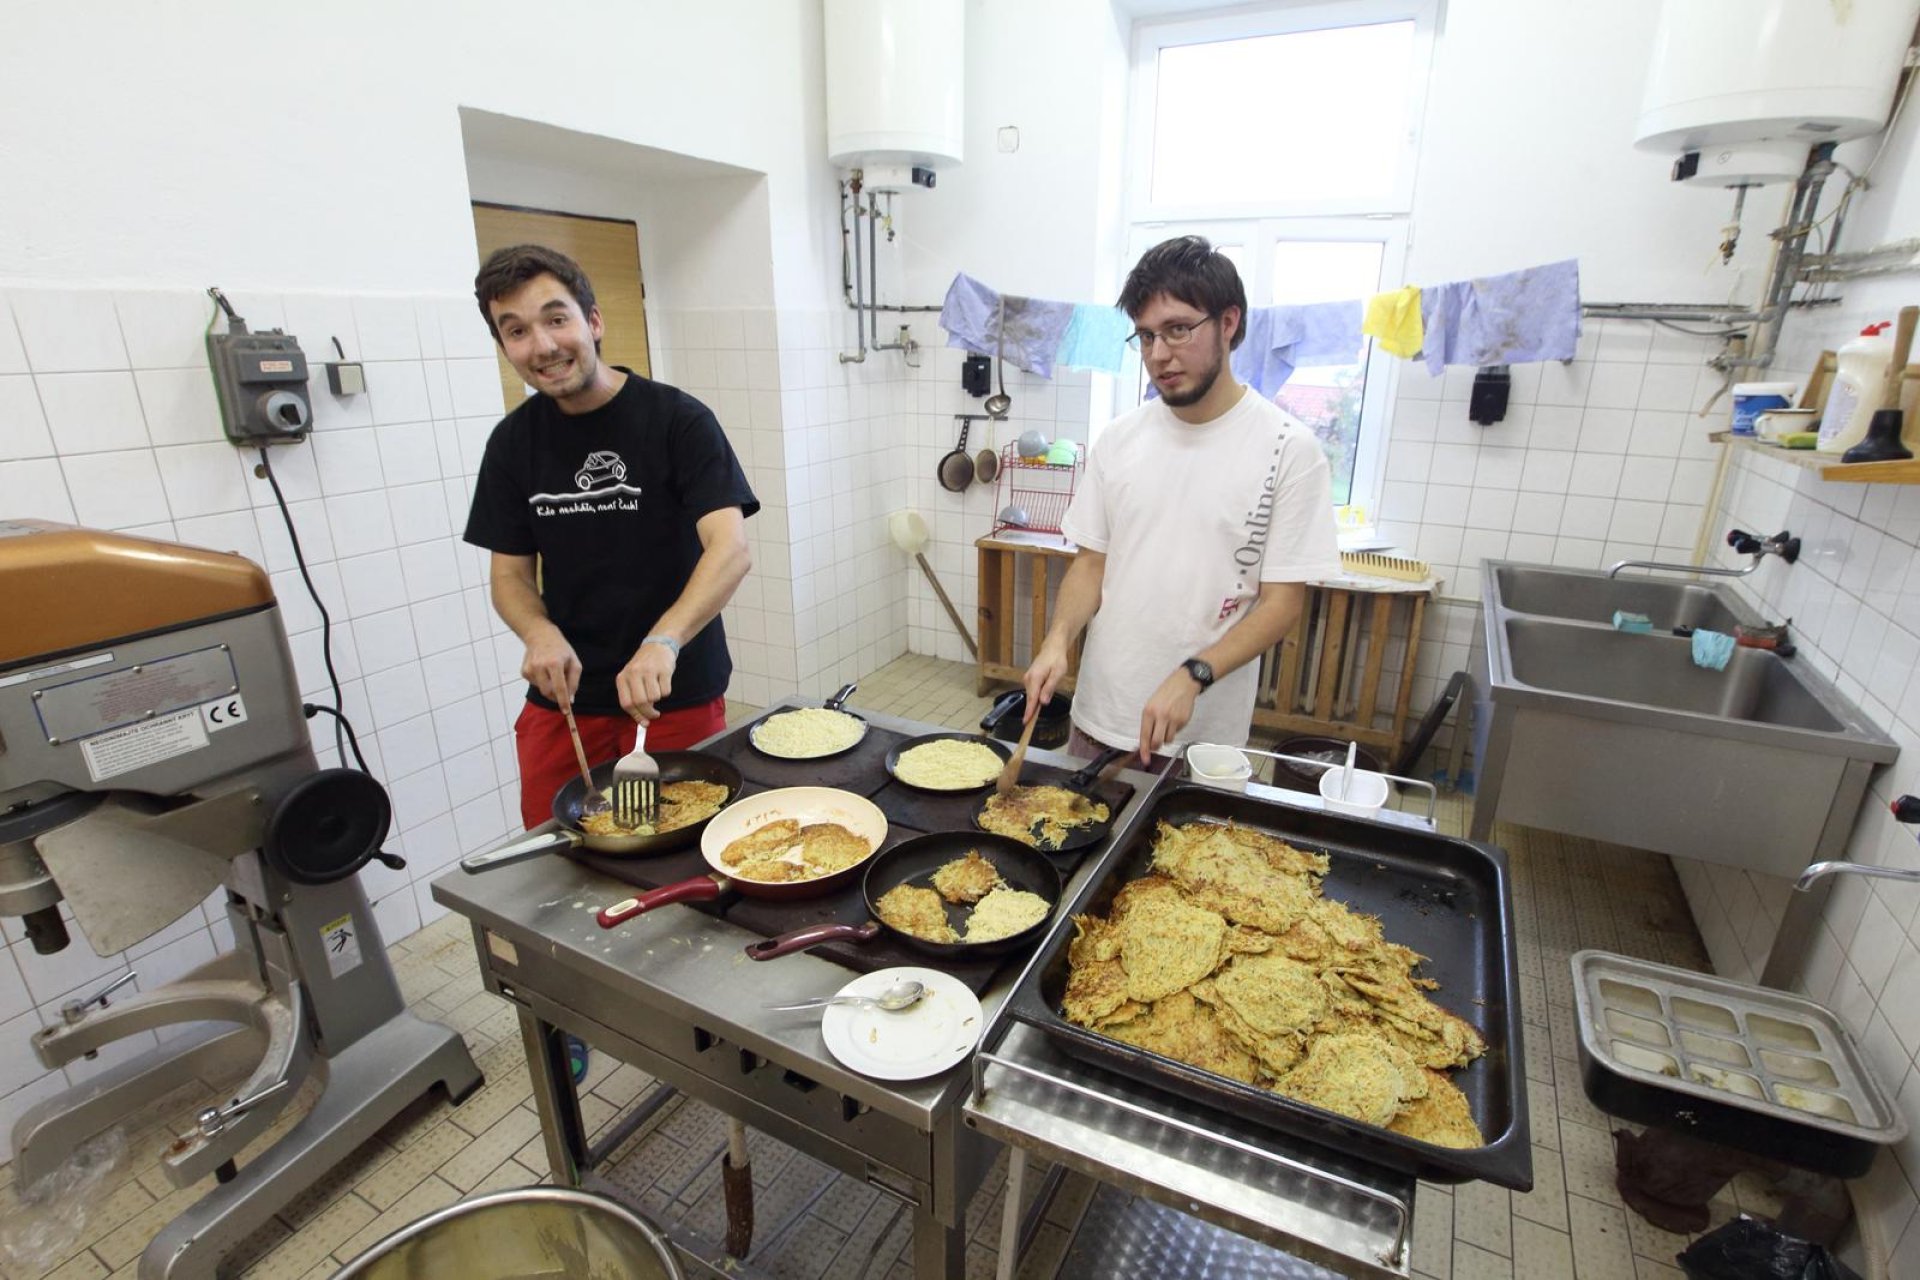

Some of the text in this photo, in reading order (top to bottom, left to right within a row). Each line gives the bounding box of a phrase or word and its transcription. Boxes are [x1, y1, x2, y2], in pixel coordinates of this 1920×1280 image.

[536, 506, 555, 517] Kdo
[1234, 476, 1275, 567] Online
[209, 700, 240, 723] CE
